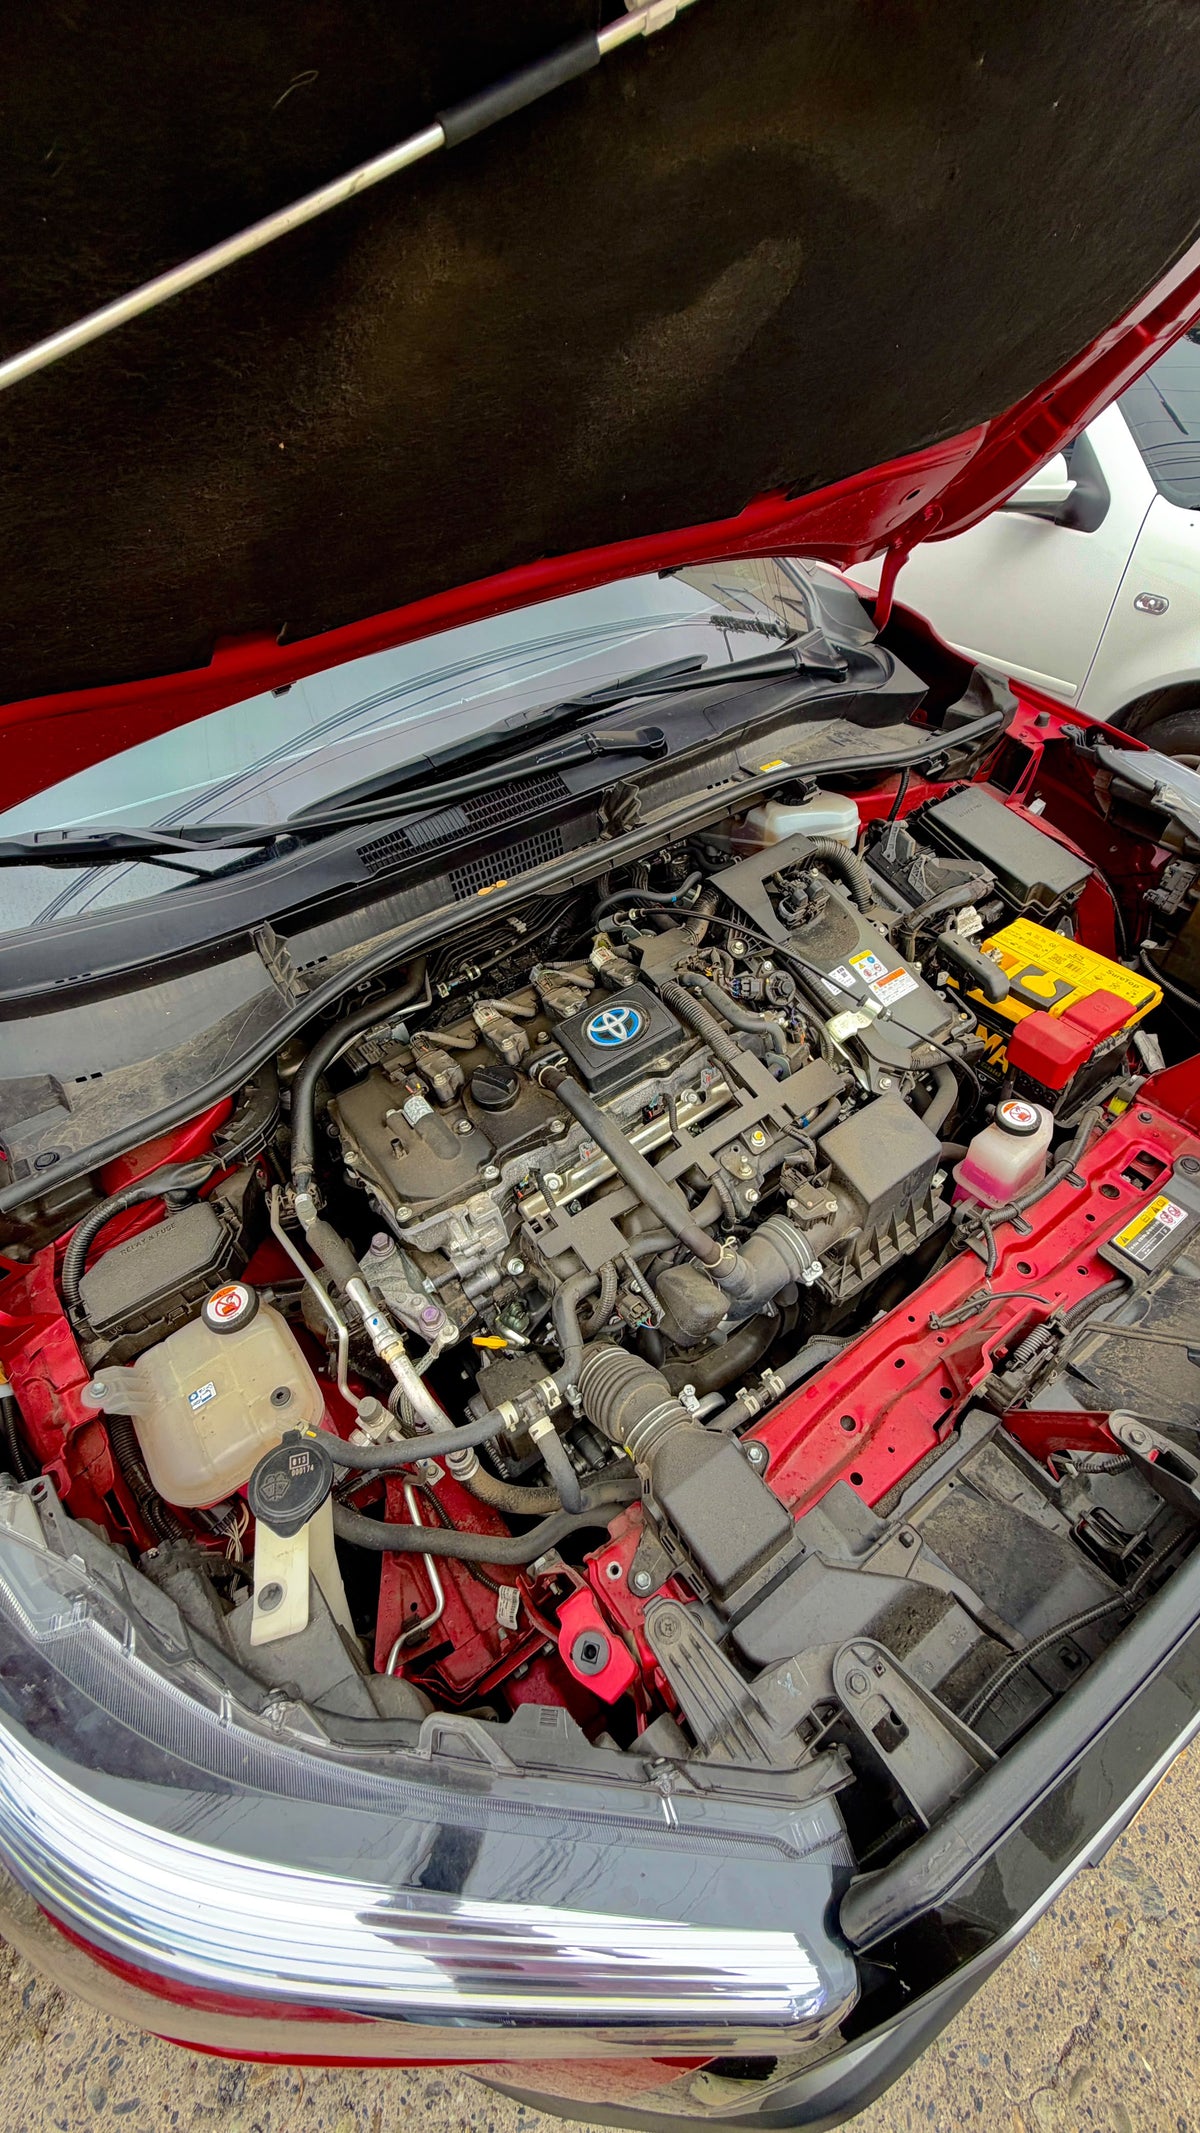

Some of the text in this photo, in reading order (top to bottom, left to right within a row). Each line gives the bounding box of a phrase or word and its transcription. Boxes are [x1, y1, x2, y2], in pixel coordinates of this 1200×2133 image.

[1106, 969, 1140, 989] SureTop
[120, 1238, 146, 1256] RELAY
[155, 1222, 177, 1237] FUSE
